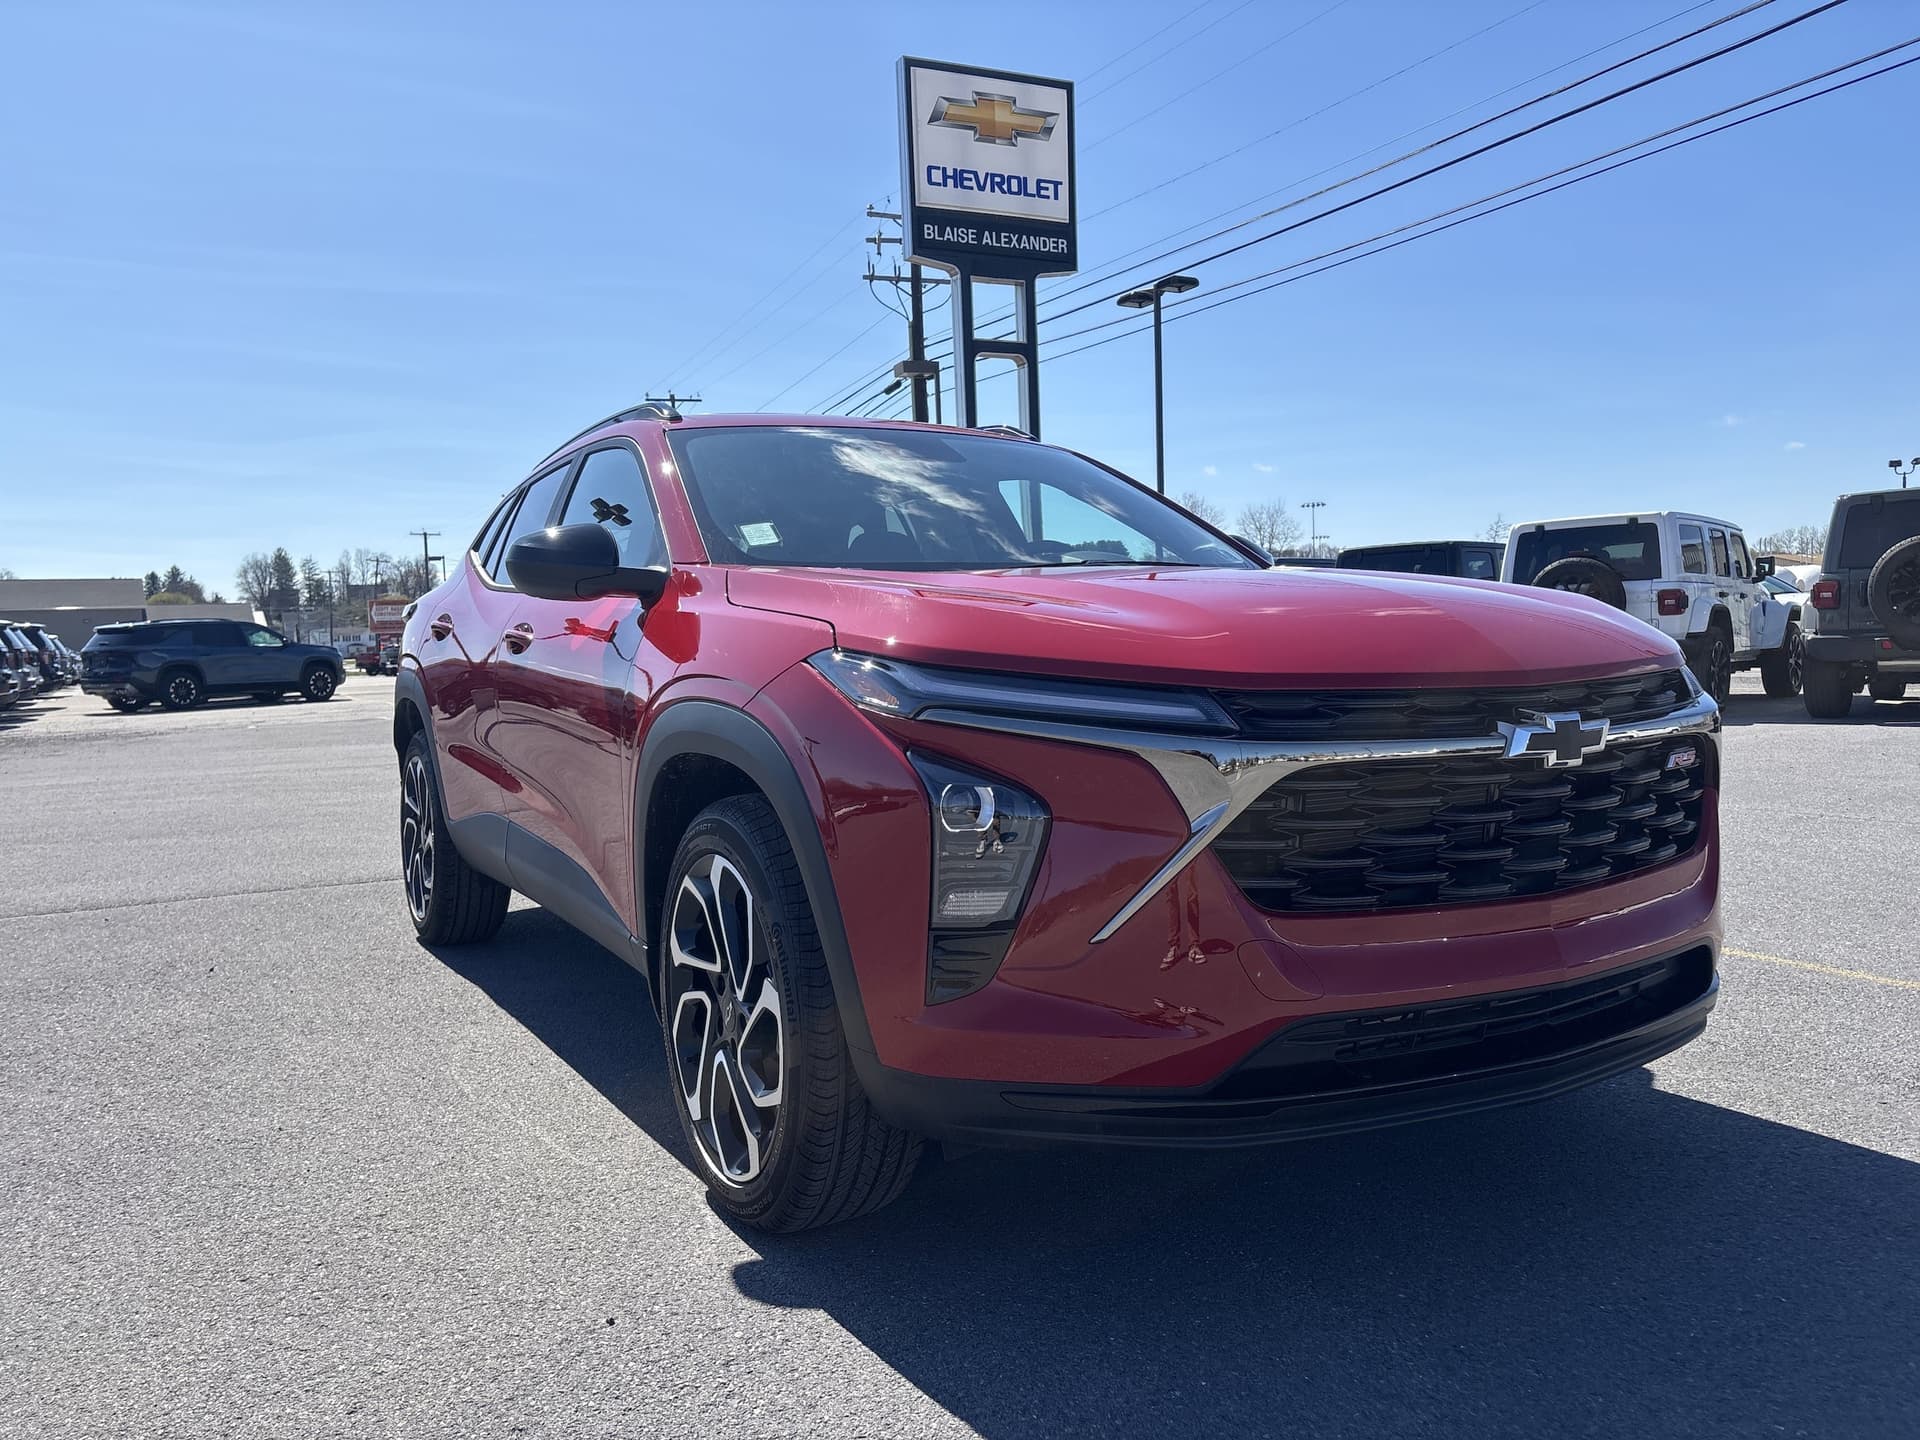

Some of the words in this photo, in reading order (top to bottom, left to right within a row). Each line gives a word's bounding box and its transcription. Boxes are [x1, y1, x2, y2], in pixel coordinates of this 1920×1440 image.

[926, 165, 1063, 200] CHEVROLET
[924, 223, 978, 245] BLAISE
[982, 230, 1068, 254] ALEXANDER
